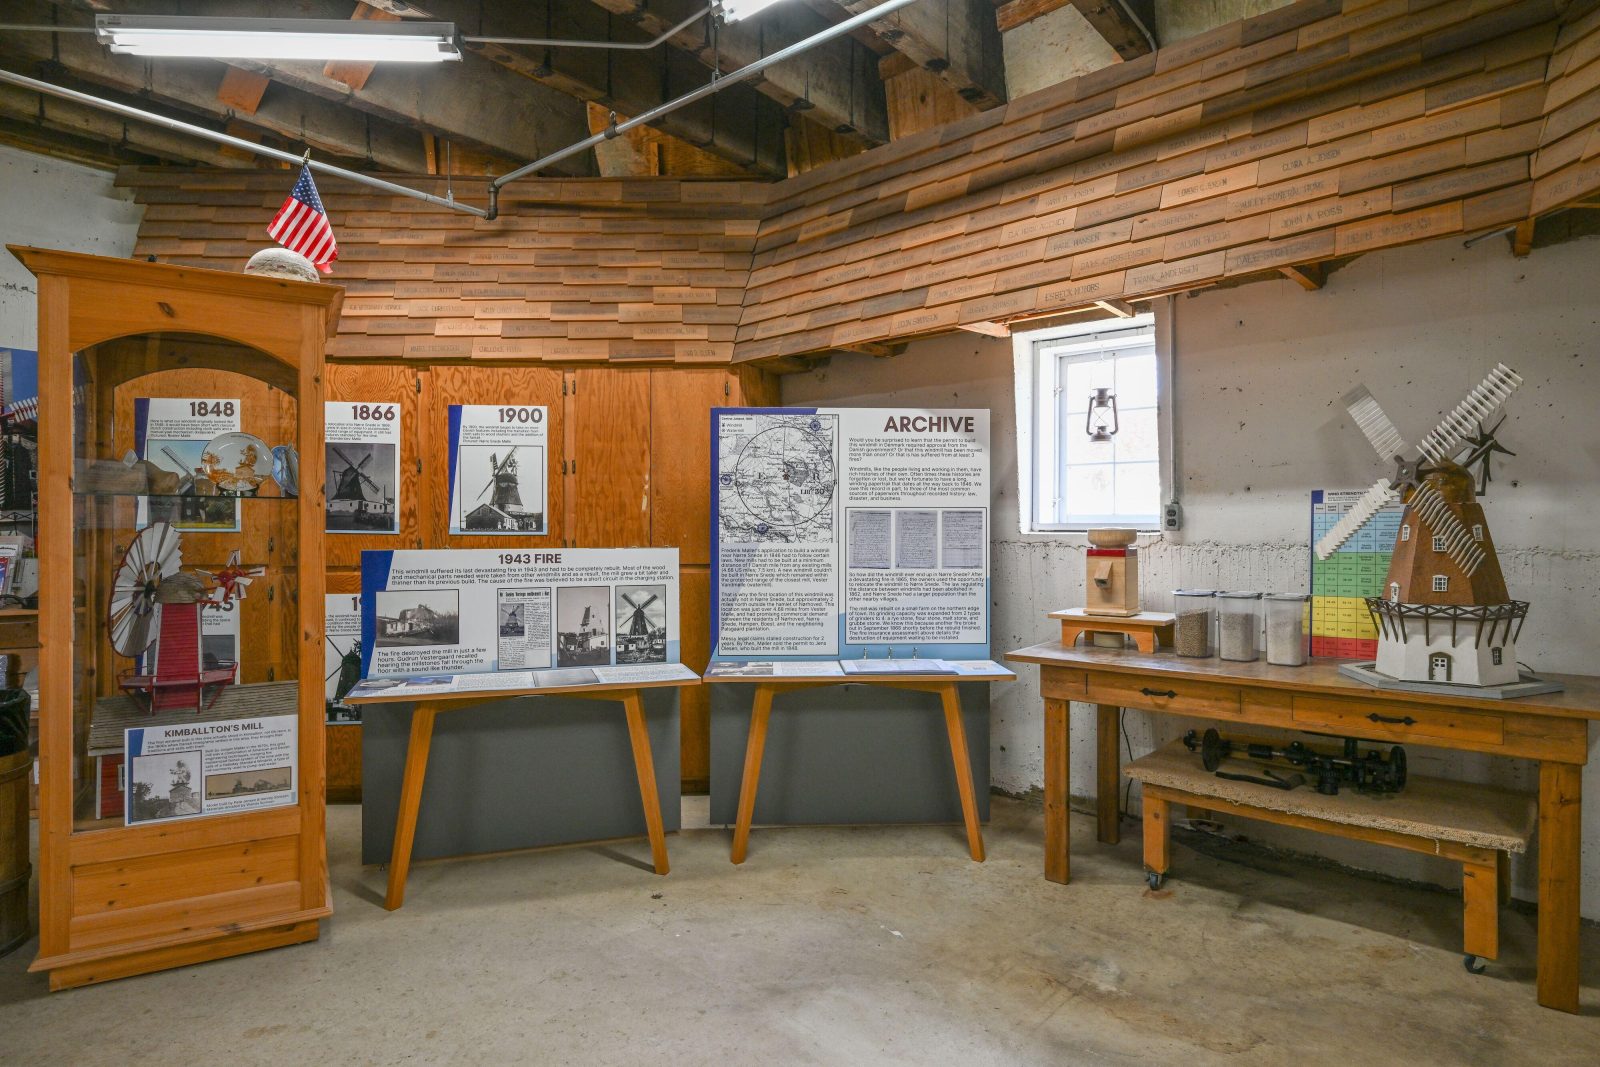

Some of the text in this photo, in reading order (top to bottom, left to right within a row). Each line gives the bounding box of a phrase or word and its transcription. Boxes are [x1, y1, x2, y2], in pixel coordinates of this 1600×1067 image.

[1317, 205, 1343, 219] ROSS
[189, 402, 234, 417] 1848
[352, 405, 395, 420] 1866
[498, 408, 542, 423] 1900
[884, 416, 974, 432] ARCHIVE
[498, 554, 562, 564] 1943 FIRE
[165, 722, 264, 737] KIMBALLTON'S MILL
